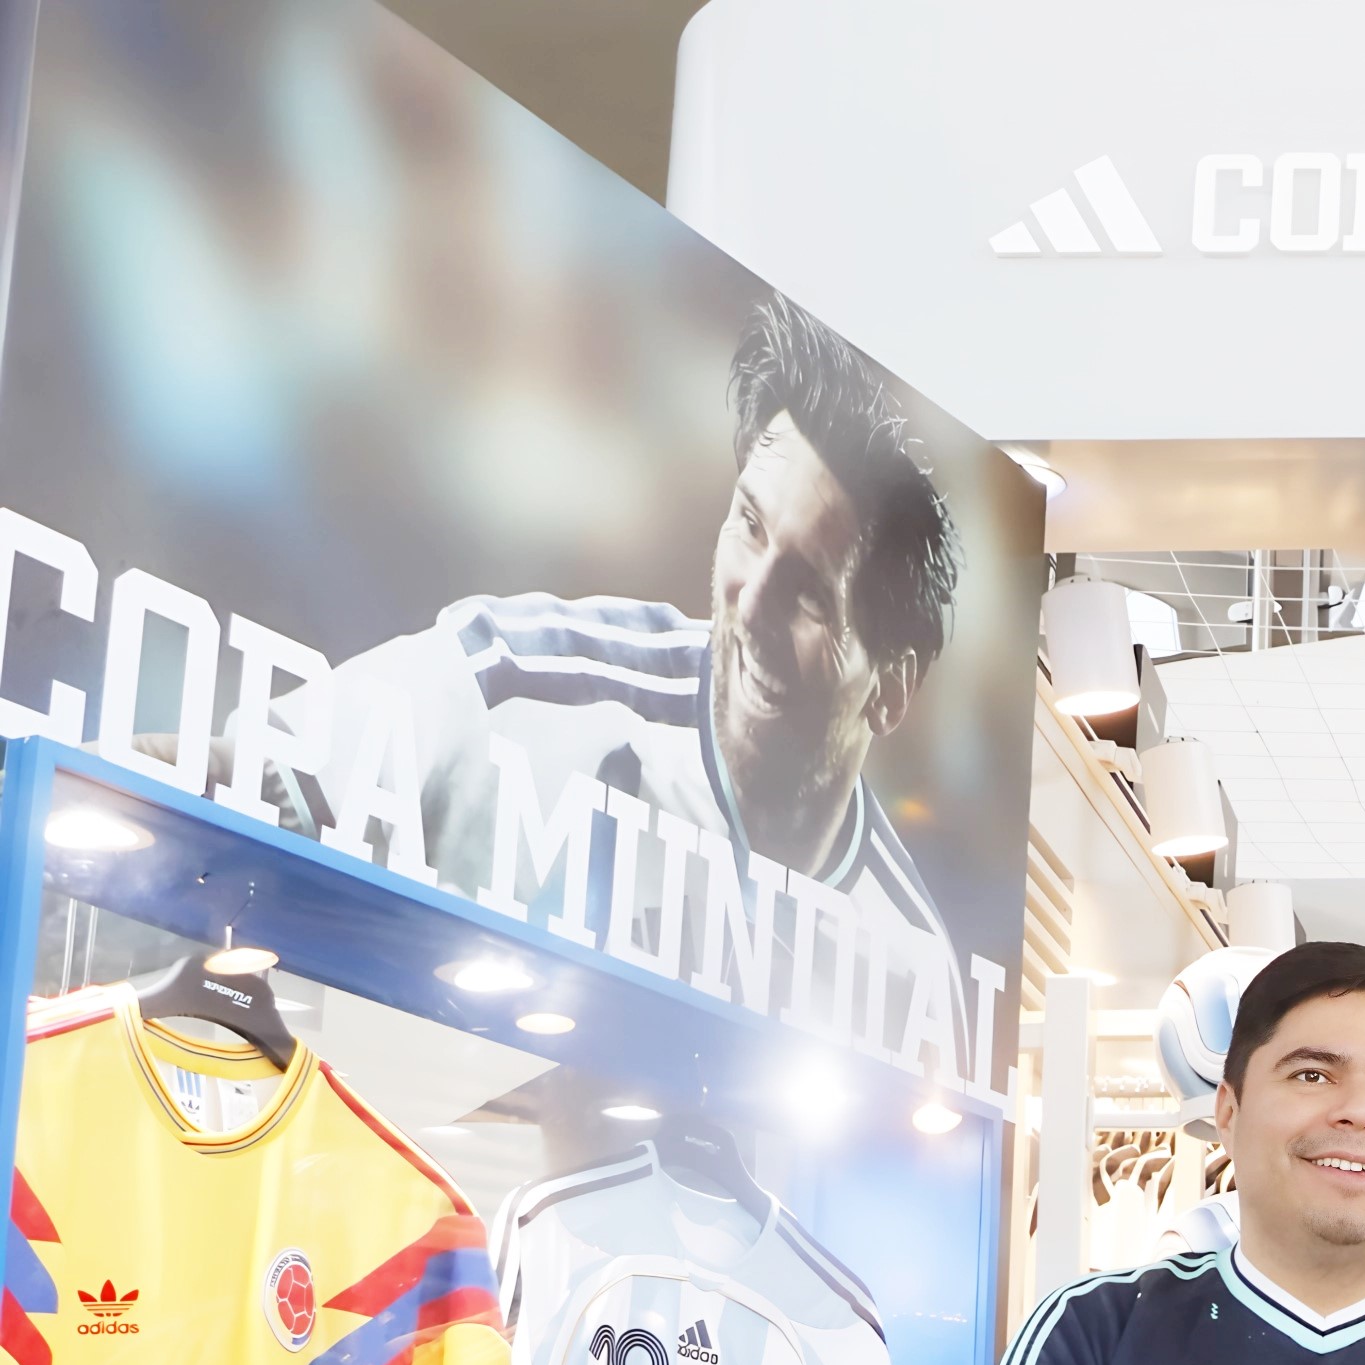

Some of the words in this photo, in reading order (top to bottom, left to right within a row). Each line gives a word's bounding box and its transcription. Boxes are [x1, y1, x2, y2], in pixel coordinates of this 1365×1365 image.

[0, 507, 438, 888] COPA
[477, 731, 1018, 1124] MUNDIAL
[77, 1321, 140, 1335] adidas
